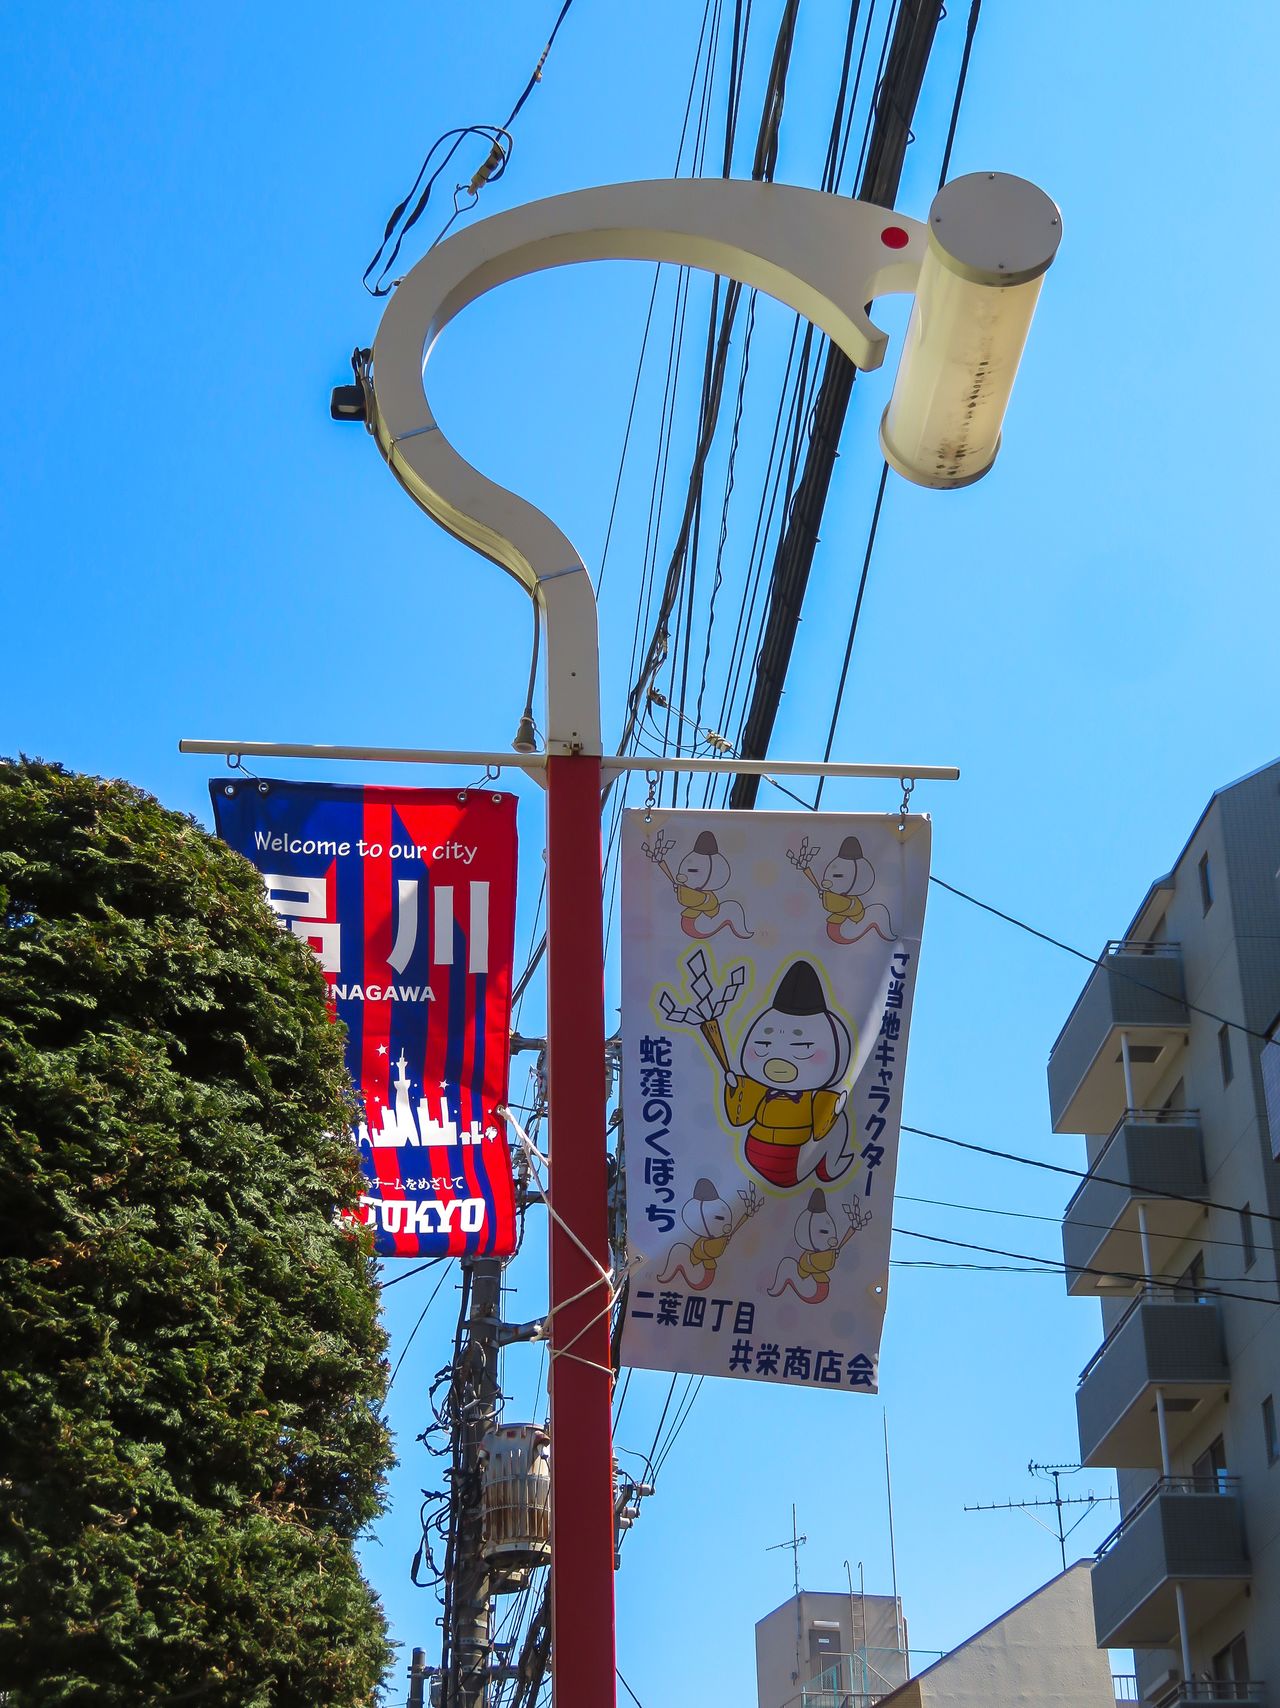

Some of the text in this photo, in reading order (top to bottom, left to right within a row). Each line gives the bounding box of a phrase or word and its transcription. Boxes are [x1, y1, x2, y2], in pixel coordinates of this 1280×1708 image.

[254, 831, 478, 865] Welcome to our city
[639, 1035, 677, 1234] 蛇窪のくぼっち
[631, 1290, 755, 1335] 二葉四丁目
[729, 1338, 874, 1387] 共栄商店会
